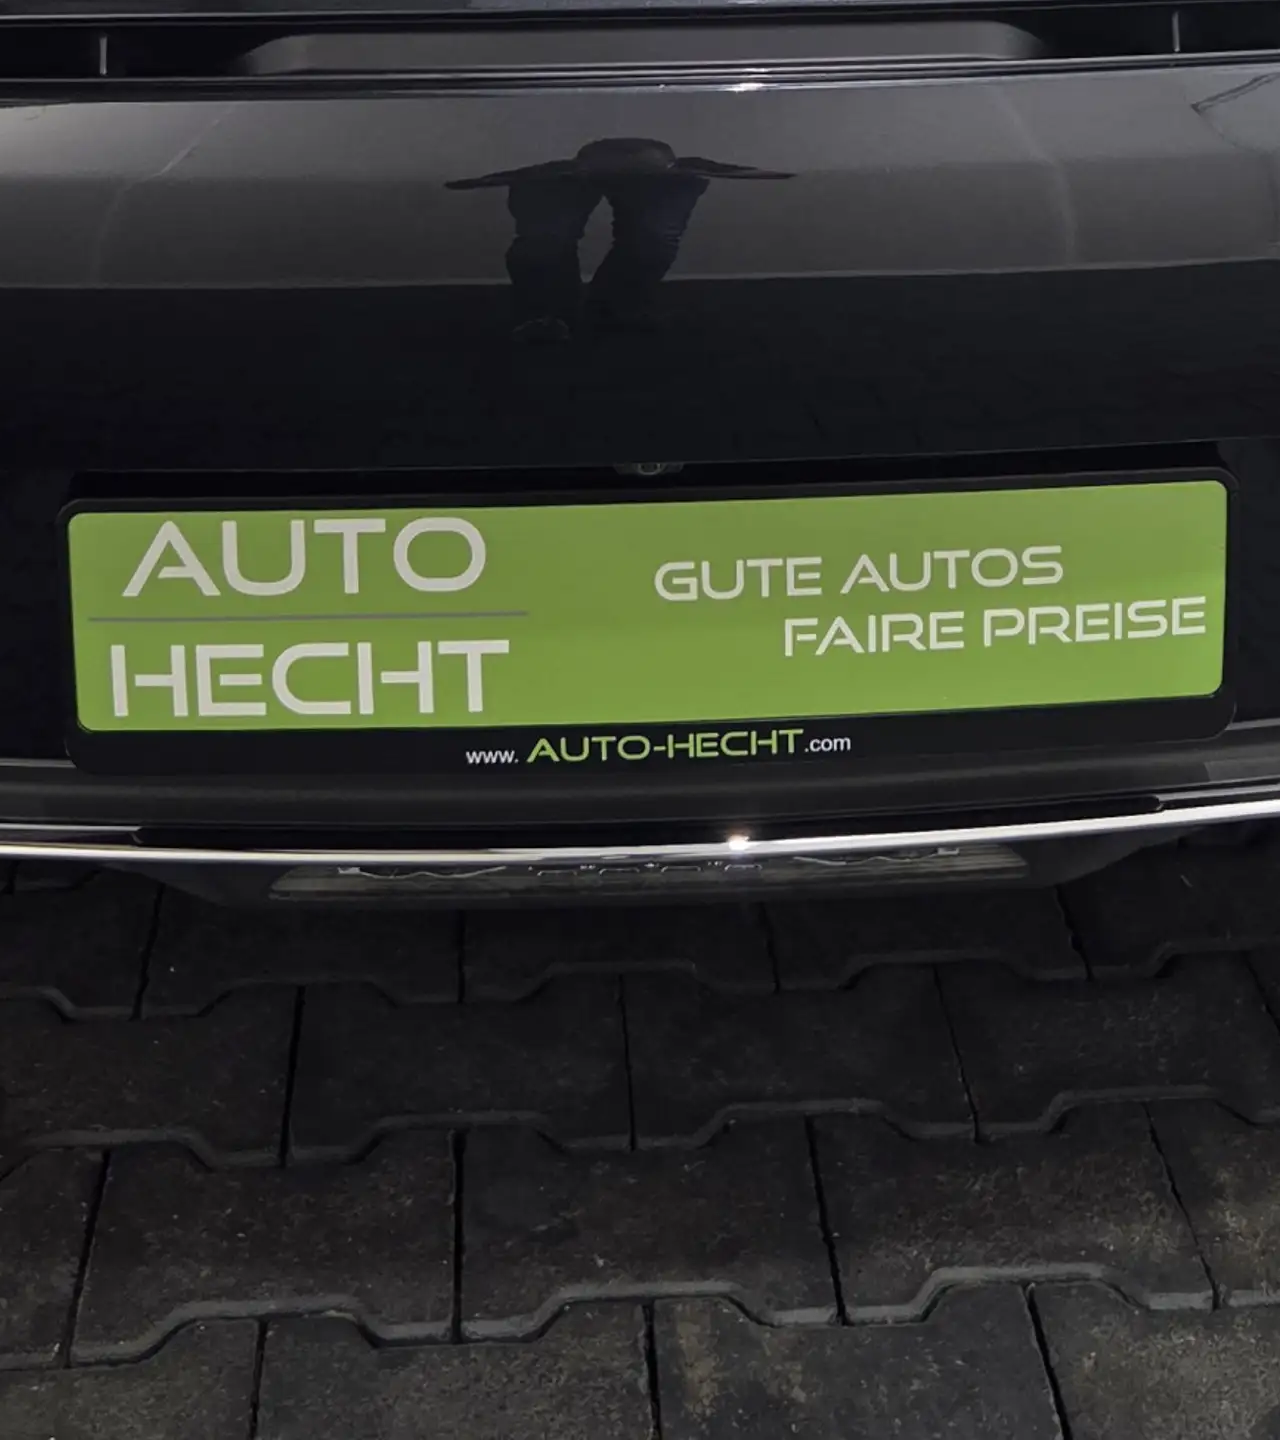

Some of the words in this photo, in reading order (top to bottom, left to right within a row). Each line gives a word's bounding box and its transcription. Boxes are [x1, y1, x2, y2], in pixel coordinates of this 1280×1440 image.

[122, 516, 487, 597] AUTO
[654, 556, 823, 602] GUTE
[840, 545, 1064, 595] AUTOS
[784, 611, 965, 657] FAIRE
[983, 596, 1207, 647] PREISE
[110, 639, 510, 718] HECHT
